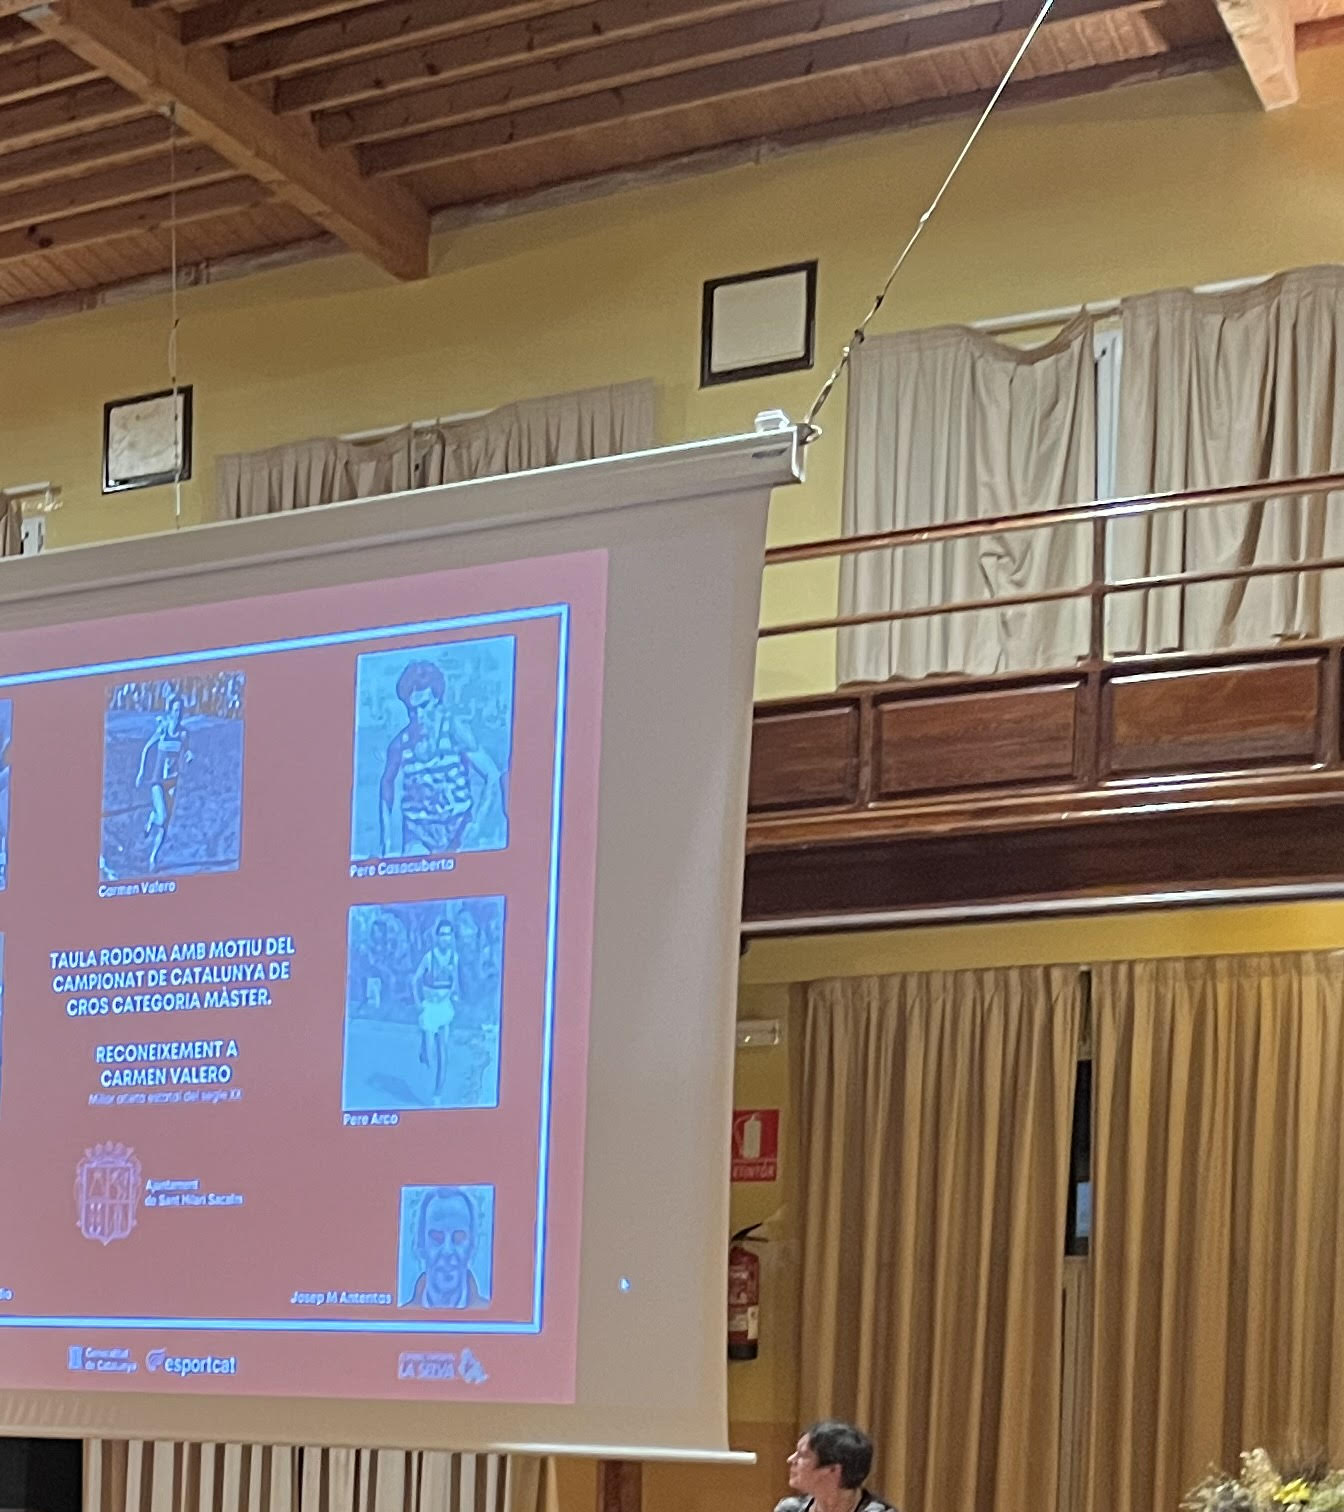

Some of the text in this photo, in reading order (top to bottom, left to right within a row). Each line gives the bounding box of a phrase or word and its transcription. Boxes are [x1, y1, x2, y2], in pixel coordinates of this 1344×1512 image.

[350, 859, 454, 877] Pere Casacuberta
[98, 880, 176, 898] Carmen Valero
[49, 936, 295, 969] TAULA RODONA AMB MOTIU DEL
[52, 961, 290, 992] CAMPIONAT DE CATALUNYA DE
[66, 986, 273, 1016] CROS CATEGORIA MÀSTER.
[95, 1039, 239, 1063] RECONEIXEMENT A
[100, 1065, 232, 1088] CARMEN VALERO
[343, 1112, 398, 1126] Pere Arco
[290, 1291, 325, 1306] Josep
[325, 1291, 338, 1303] M
[164, 1356, 236, 1377] esportcat
